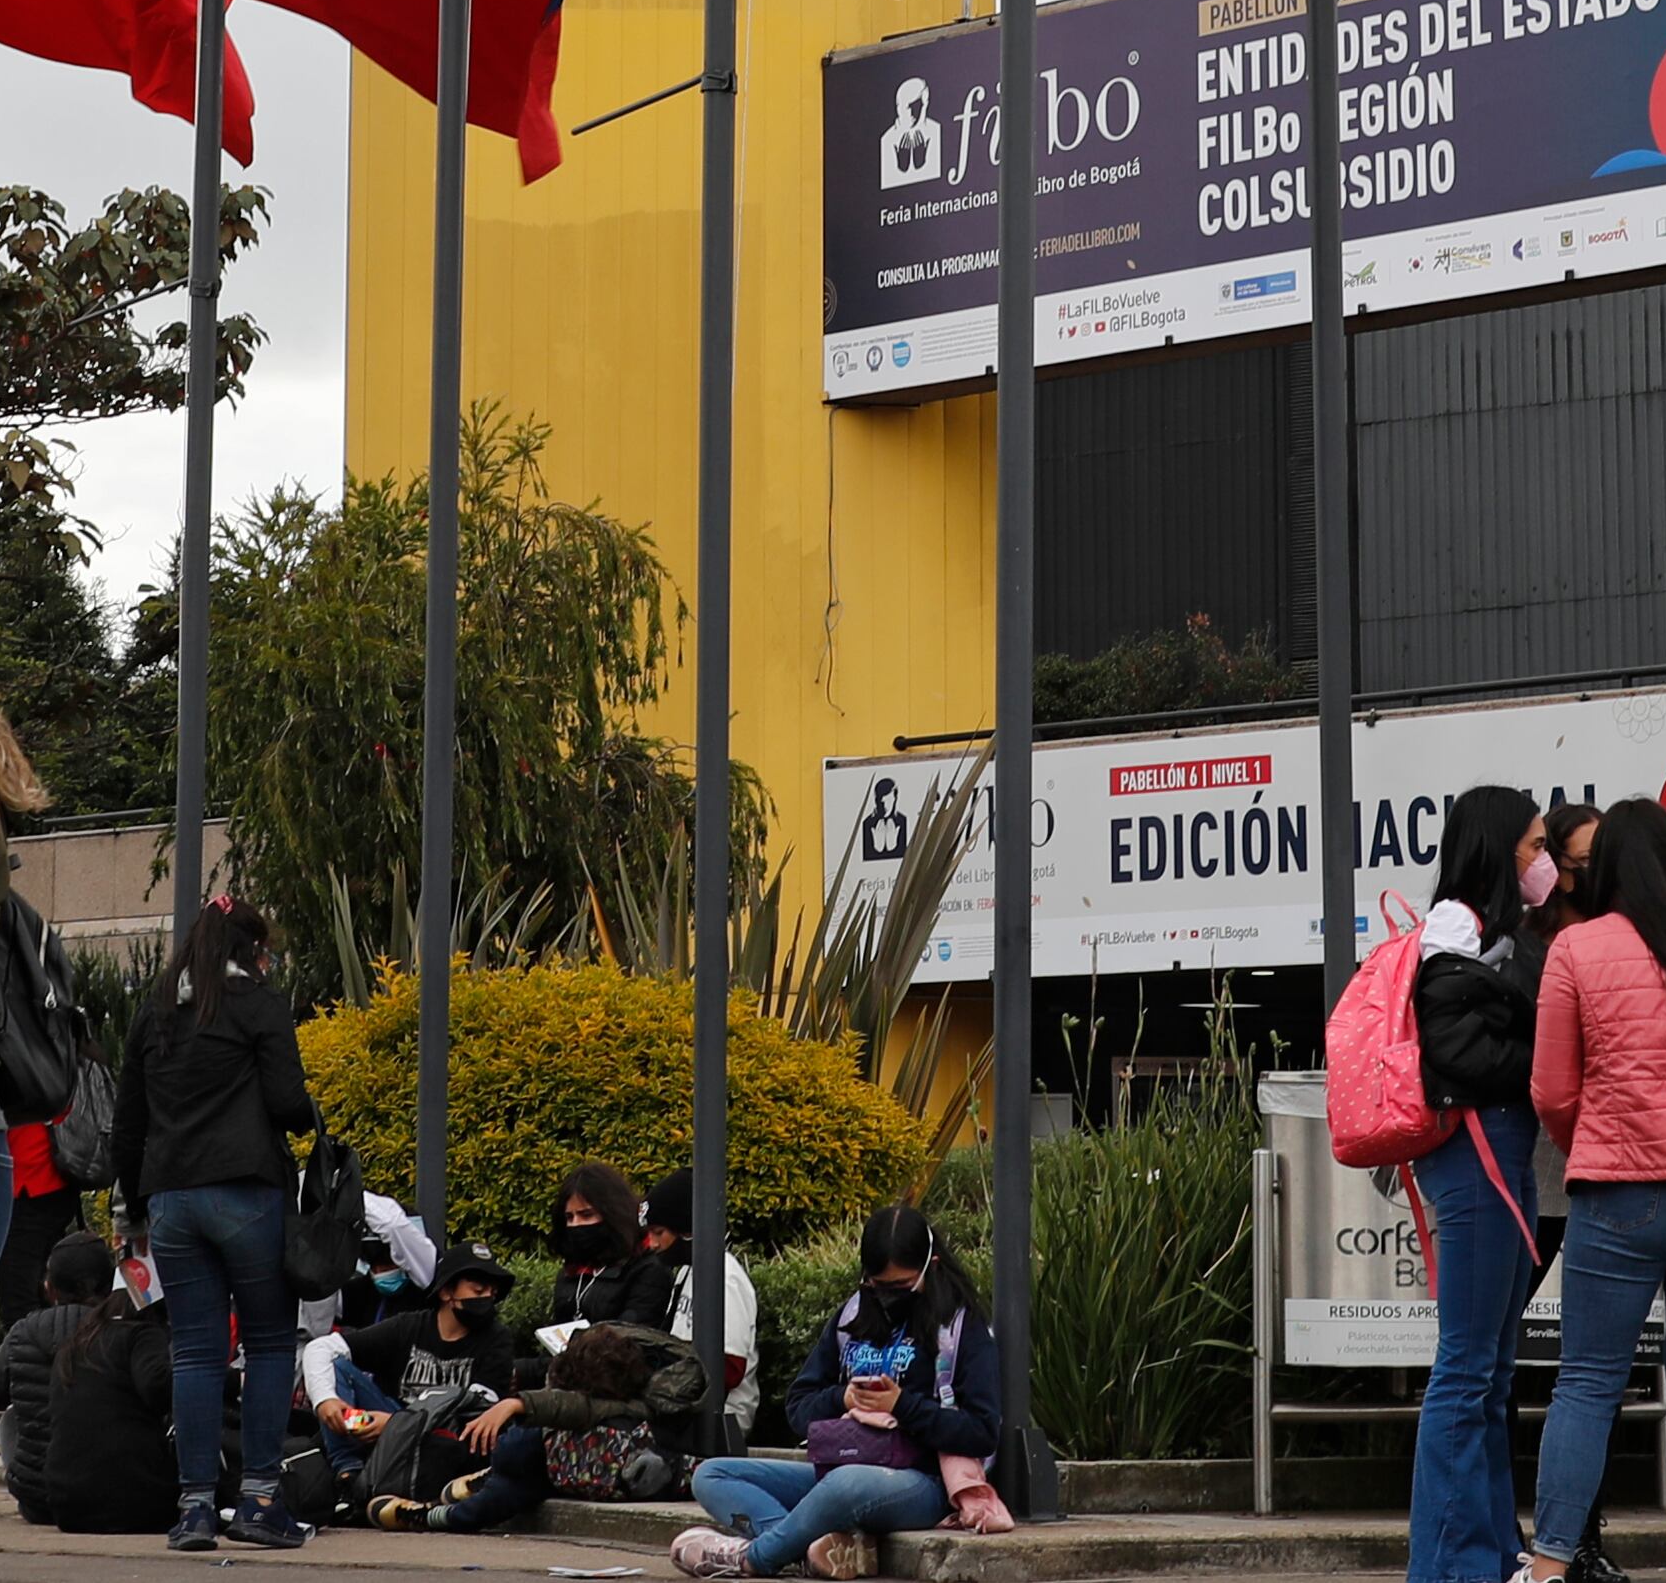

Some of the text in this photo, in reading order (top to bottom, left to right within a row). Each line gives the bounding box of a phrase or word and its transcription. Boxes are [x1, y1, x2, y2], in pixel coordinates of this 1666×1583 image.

[1197, 9, 1409, 103] ENTIDDES
[947, 67, 1141, 186] fibo
[1197, 61, 1454, 169] FILBo EGIÓN
[880, 202, 912, 227] Feria
[914, 189, 998, 221] Internaciona
[1068, 169, 1087, 189] de
[1090, 156, 1141, 188] Bogotá
[877, 263, 925, 289] CONSULTA
[926, 260, 940, 280] LA
[1039, 221, 1141, 258] FERIADELLIBRO.COM
[1058, 289, 1161, 321] #LaFILBoVuelve
[1109, 306, 1186, 333] @FILBogota
[1119, 760, 1262, 792] PABELLÓN 6 NIVEL 1
[1109, 790, 1308, 884] EDICIÓN
[956, 869, 973, 884] del
[974, 868, 995, 883] Libr
[1329, 1305, 1403, 1319] RESIDUOS
